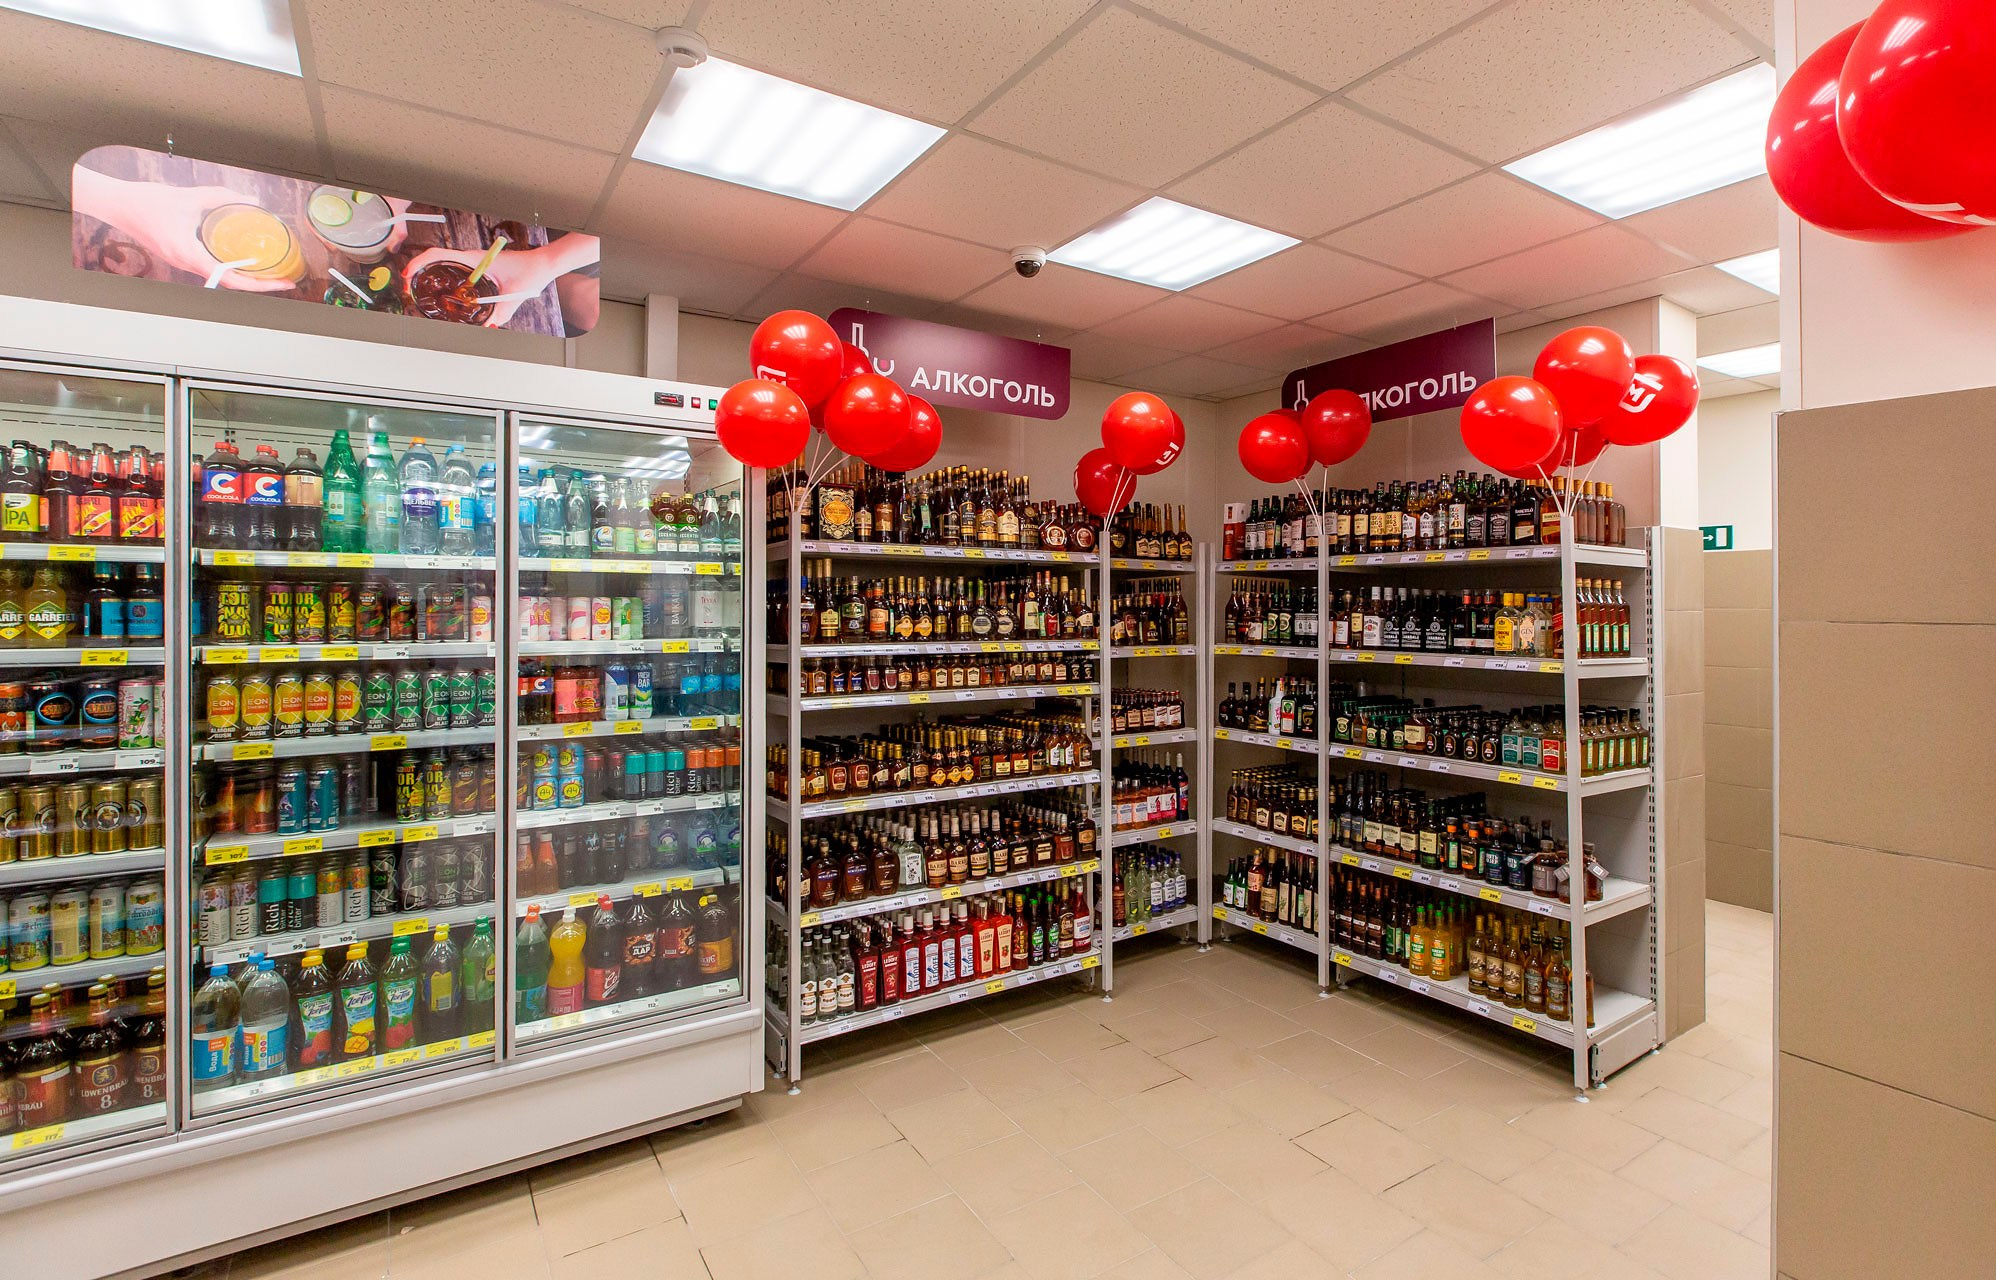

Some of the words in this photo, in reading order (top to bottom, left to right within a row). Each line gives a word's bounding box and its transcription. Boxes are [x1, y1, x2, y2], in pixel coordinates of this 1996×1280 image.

[911, 367, 1056, 408] АЛКОГОЛЬ
[1357, 371, 1476, 412] ЛКОГОЛЬ
[5, 509, 30, 526] IPA
[1520, 628, 1534, 636] GIN
[539, 786, 551, 796] A4
[566, 785, 578, 795] A4
[666, 771, 675, 794] Rich
[687, 770, 696, 792] Rich
[350, 890, 362, 918] Rich
[236, 907, 250, 936] Rich
[266, 903, 280, 933] Rich
